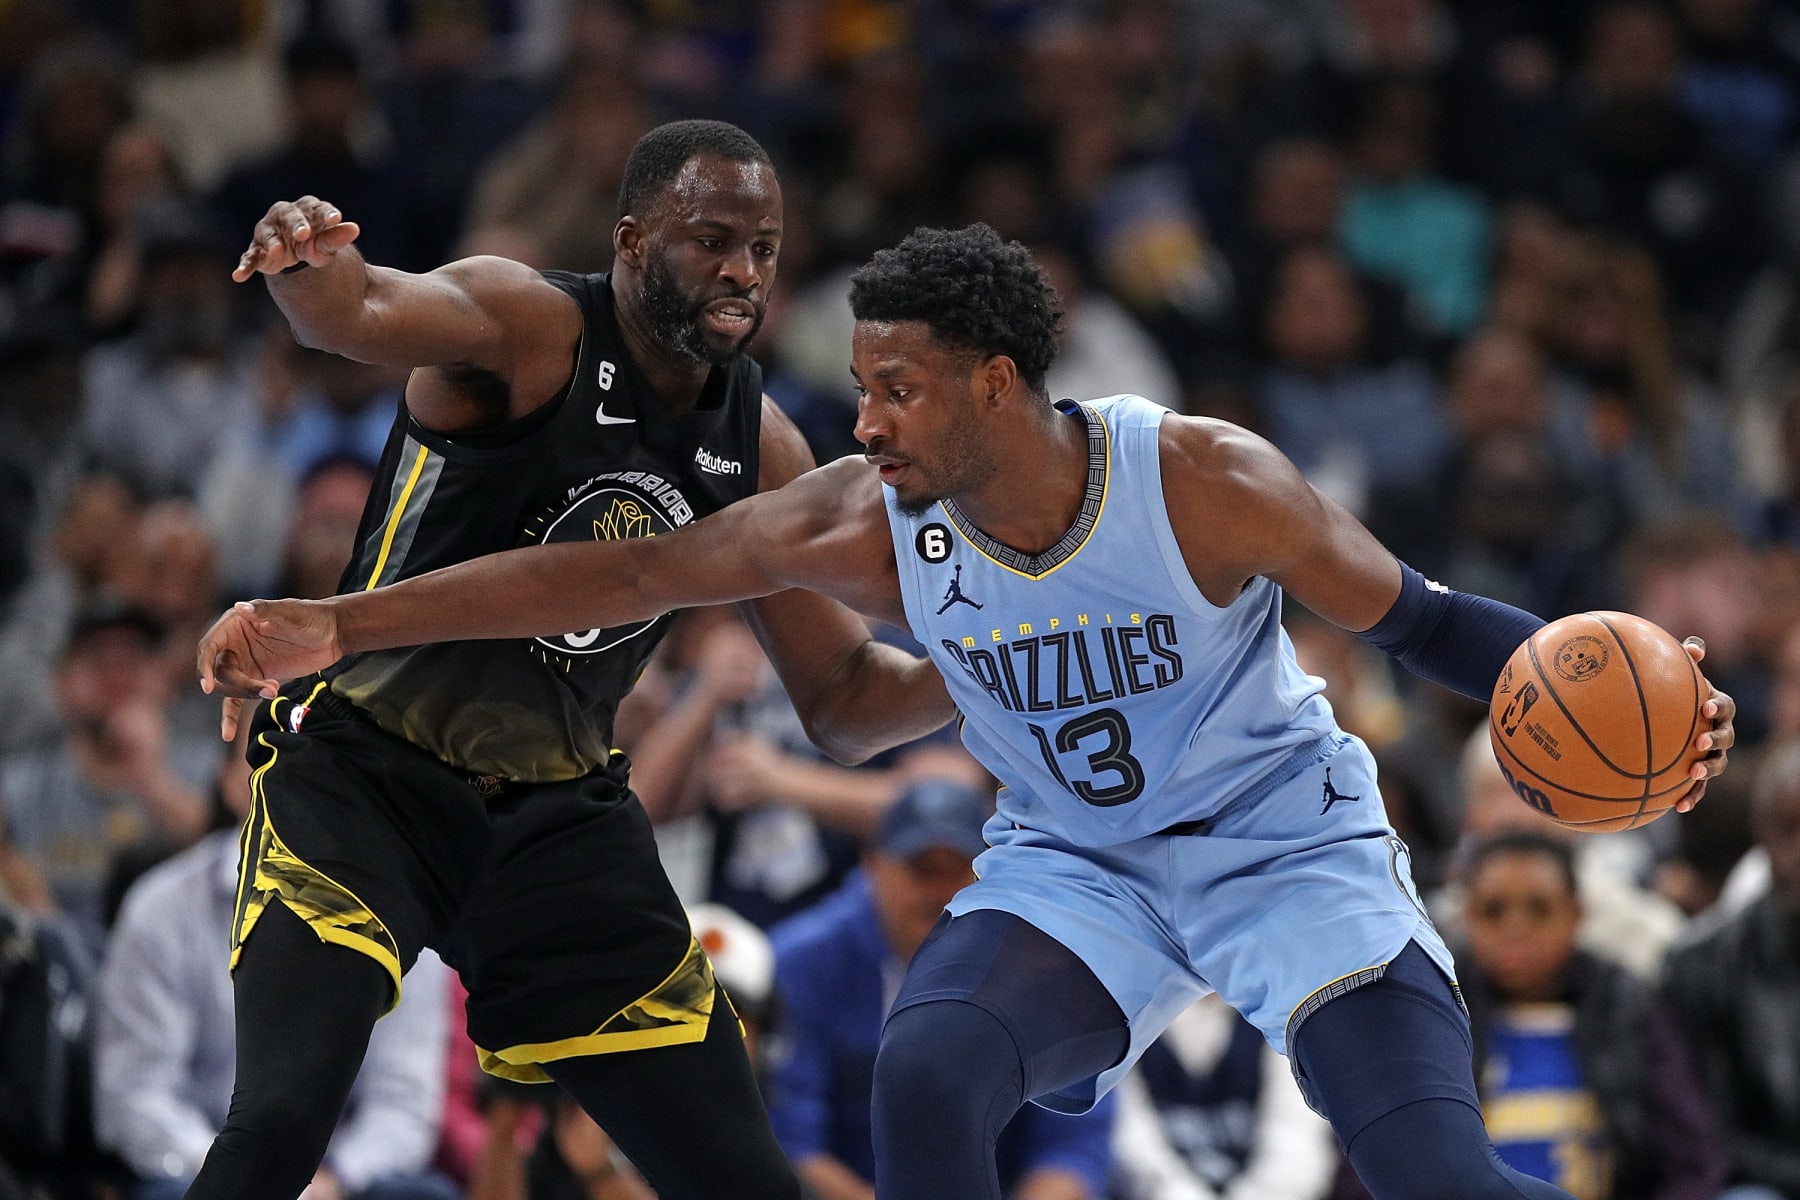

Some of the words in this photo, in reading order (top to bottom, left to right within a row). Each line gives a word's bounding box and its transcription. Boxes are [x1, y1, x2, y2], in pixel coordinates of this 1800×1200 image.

[598, 361, 615, 391] 6
[695, 447, 741, 475] Rakuten
[567, 471, 696, 528] WARRIOR
[924, 528, 946, 559] 6
[962, 613, 1141, 648] MEMPHIS
[1027, 707, 1145, 807] 13
